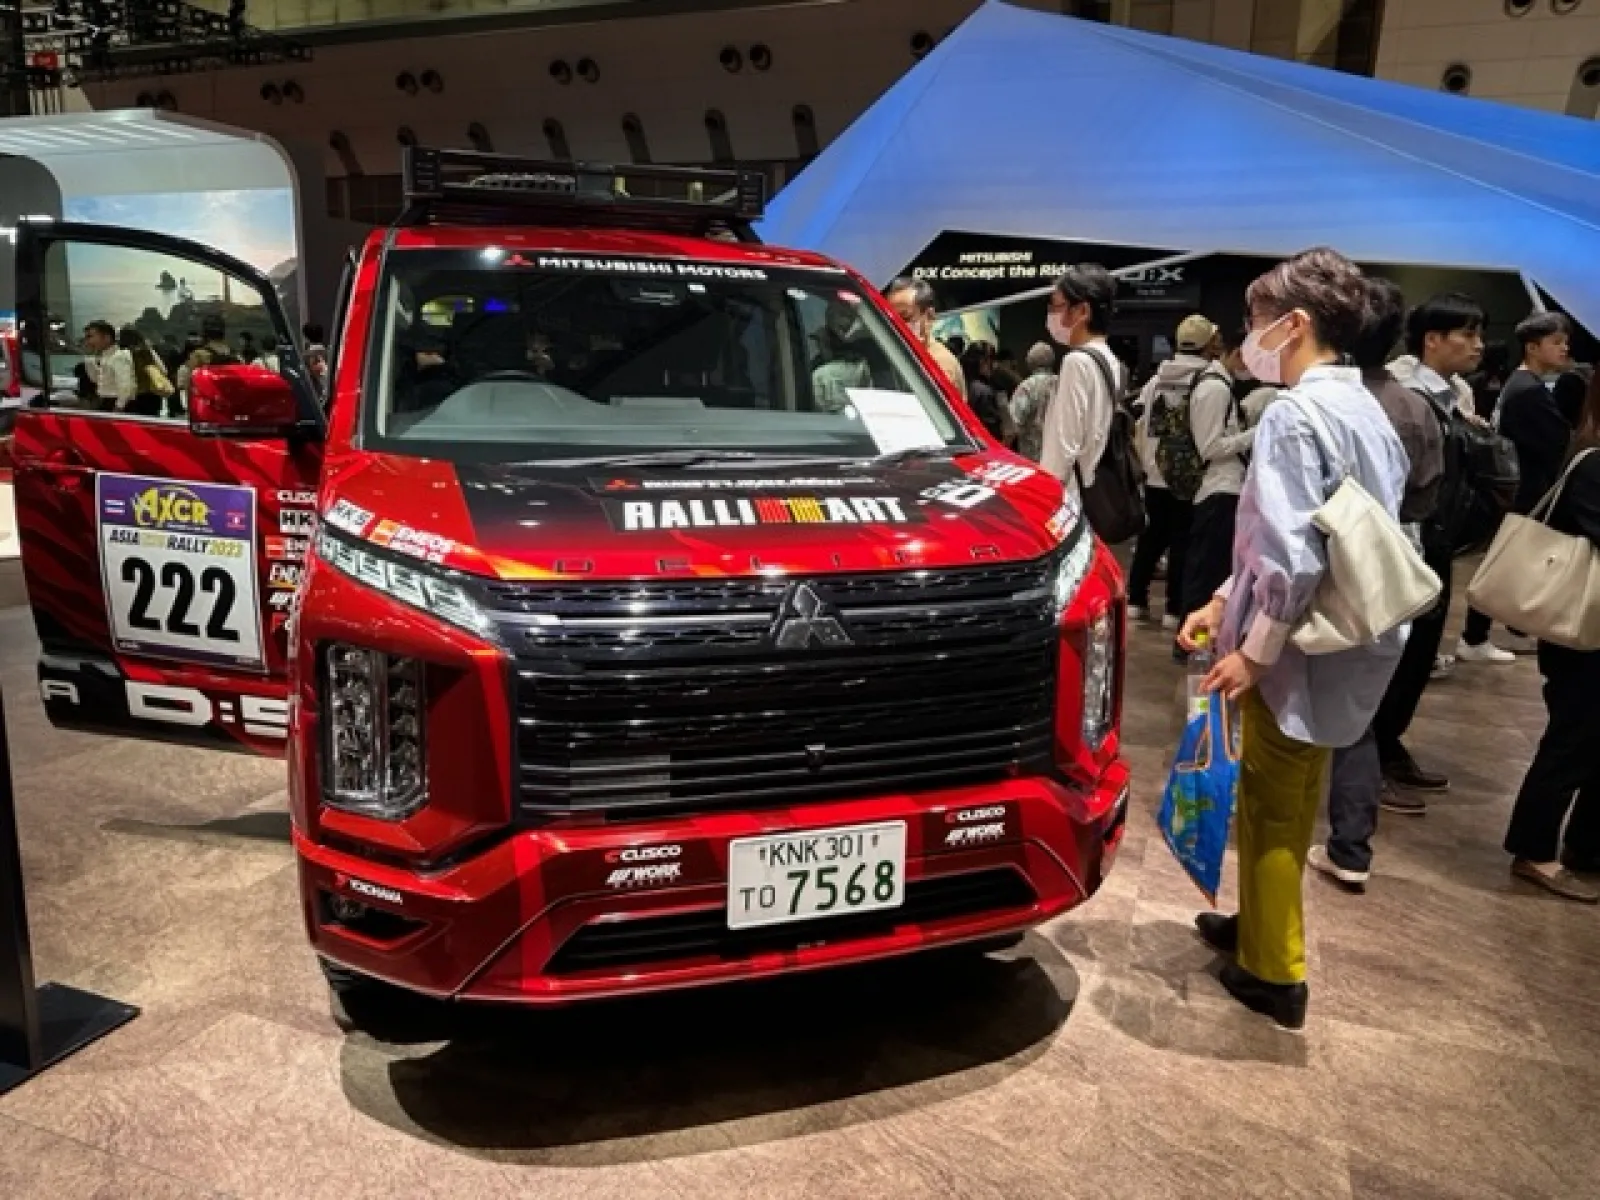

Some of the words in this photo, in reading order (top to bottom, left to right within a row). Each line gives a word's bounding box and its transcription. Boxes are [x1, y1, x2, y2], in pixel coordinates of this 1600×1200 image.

[538, 257, 674, 275] MITSUBISHI
[676, 264, 768, 280] MOTORS
[960, 251, 1034, 263] MITSUBISHI
[940, 265, 1006, 280] Concept
[1010, 264, 1036, 278] the
[134, 487, 209, 527] AXCR
[109, 529, 140, 546] ASIA
[166, 534, 209, 554] RALLY
[121, 556, 241, 643] 222
[768, 839, 820, 867] KNK
[824, 834, 864, 861] 301
[739, 884, 777, 912] TO
[786, 859, 896, 916] 7568
